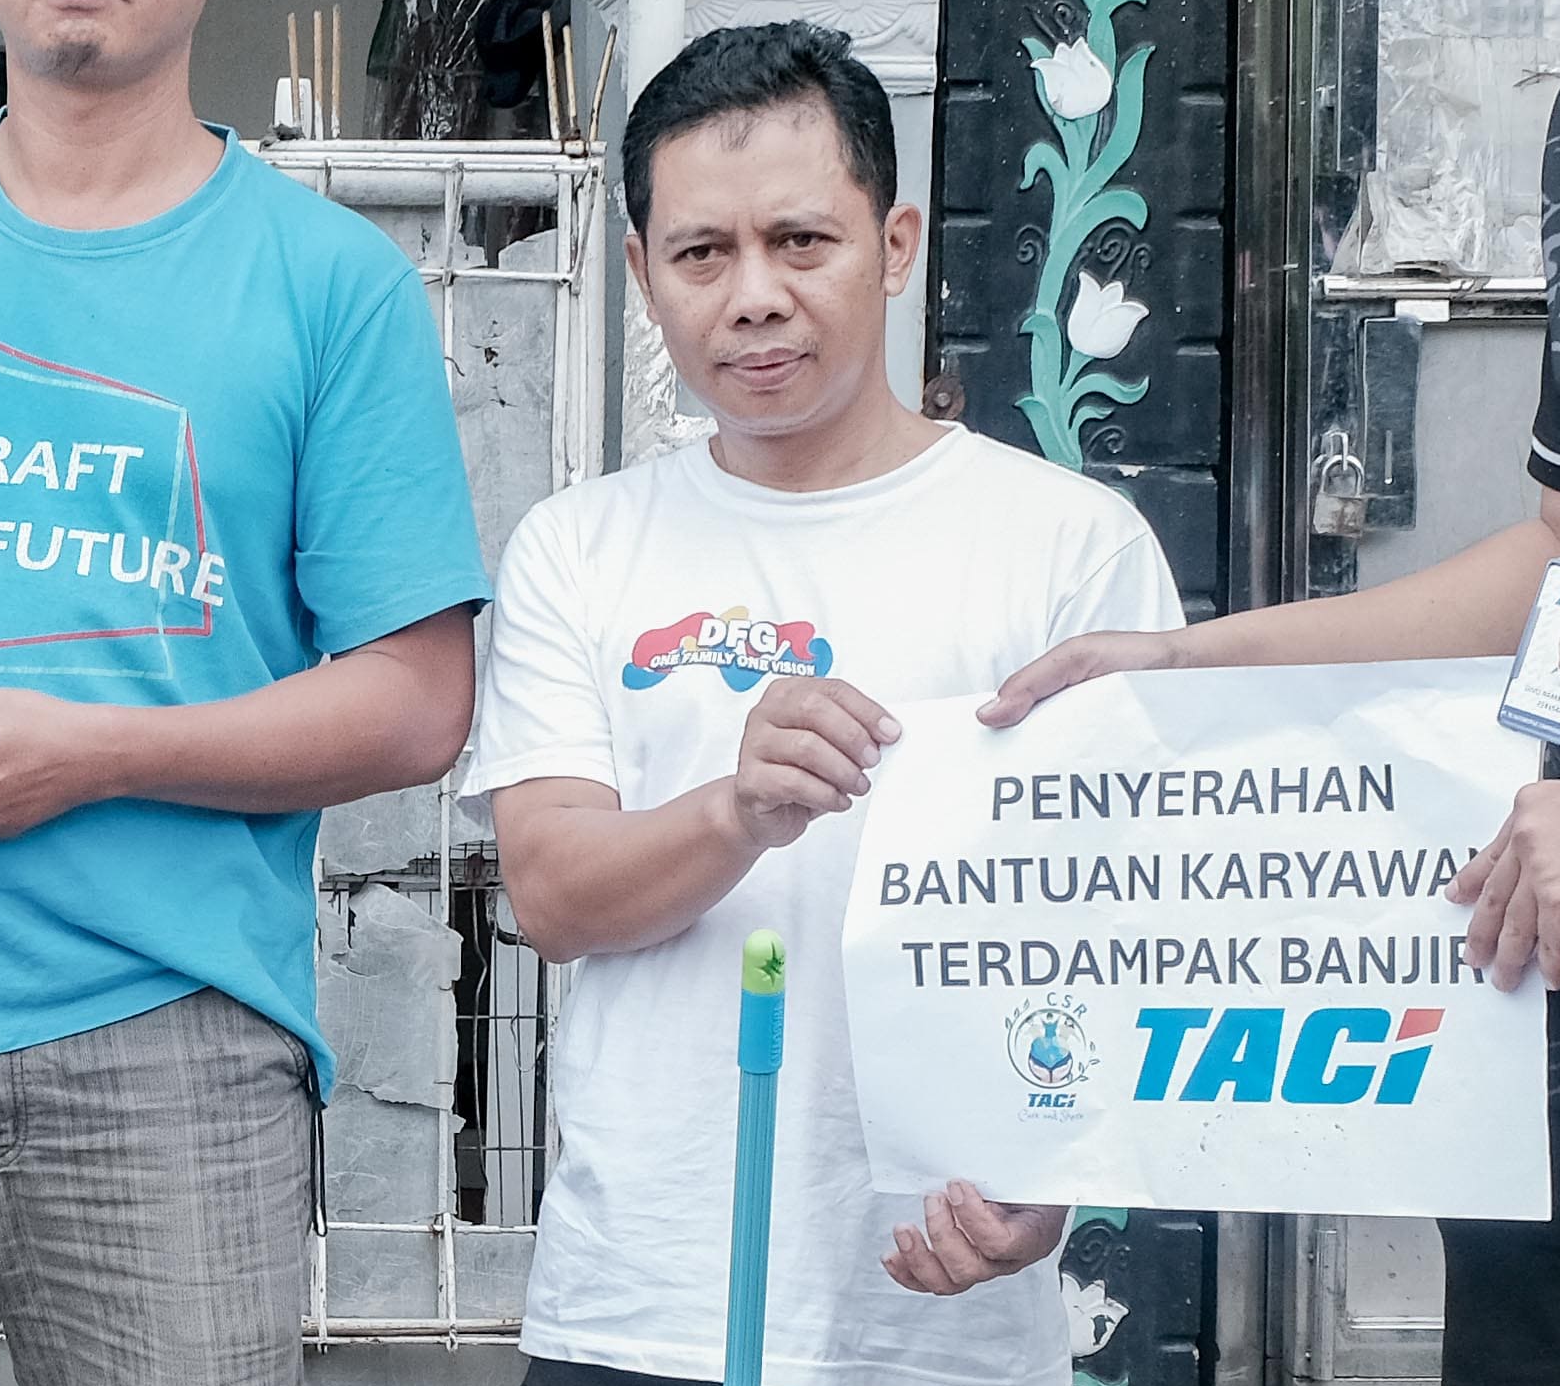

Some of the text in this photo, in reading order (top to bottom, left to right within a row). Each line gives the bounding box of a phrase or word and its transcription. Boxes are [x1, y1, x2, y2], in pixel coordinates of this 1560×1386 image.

[696, 617, 778, 655] DFG
[649, 649, 816, 678] ONE FAMILY ONE VISION
[991, 763, 1397, 822] PENYERAHAN
[879, 847, 1482, 907] BANTUAN KARYAWA
[901, 935, 1486, 989] TERDAMPAK BANJIR
[1046, 991, 1088, 1019] CSR
